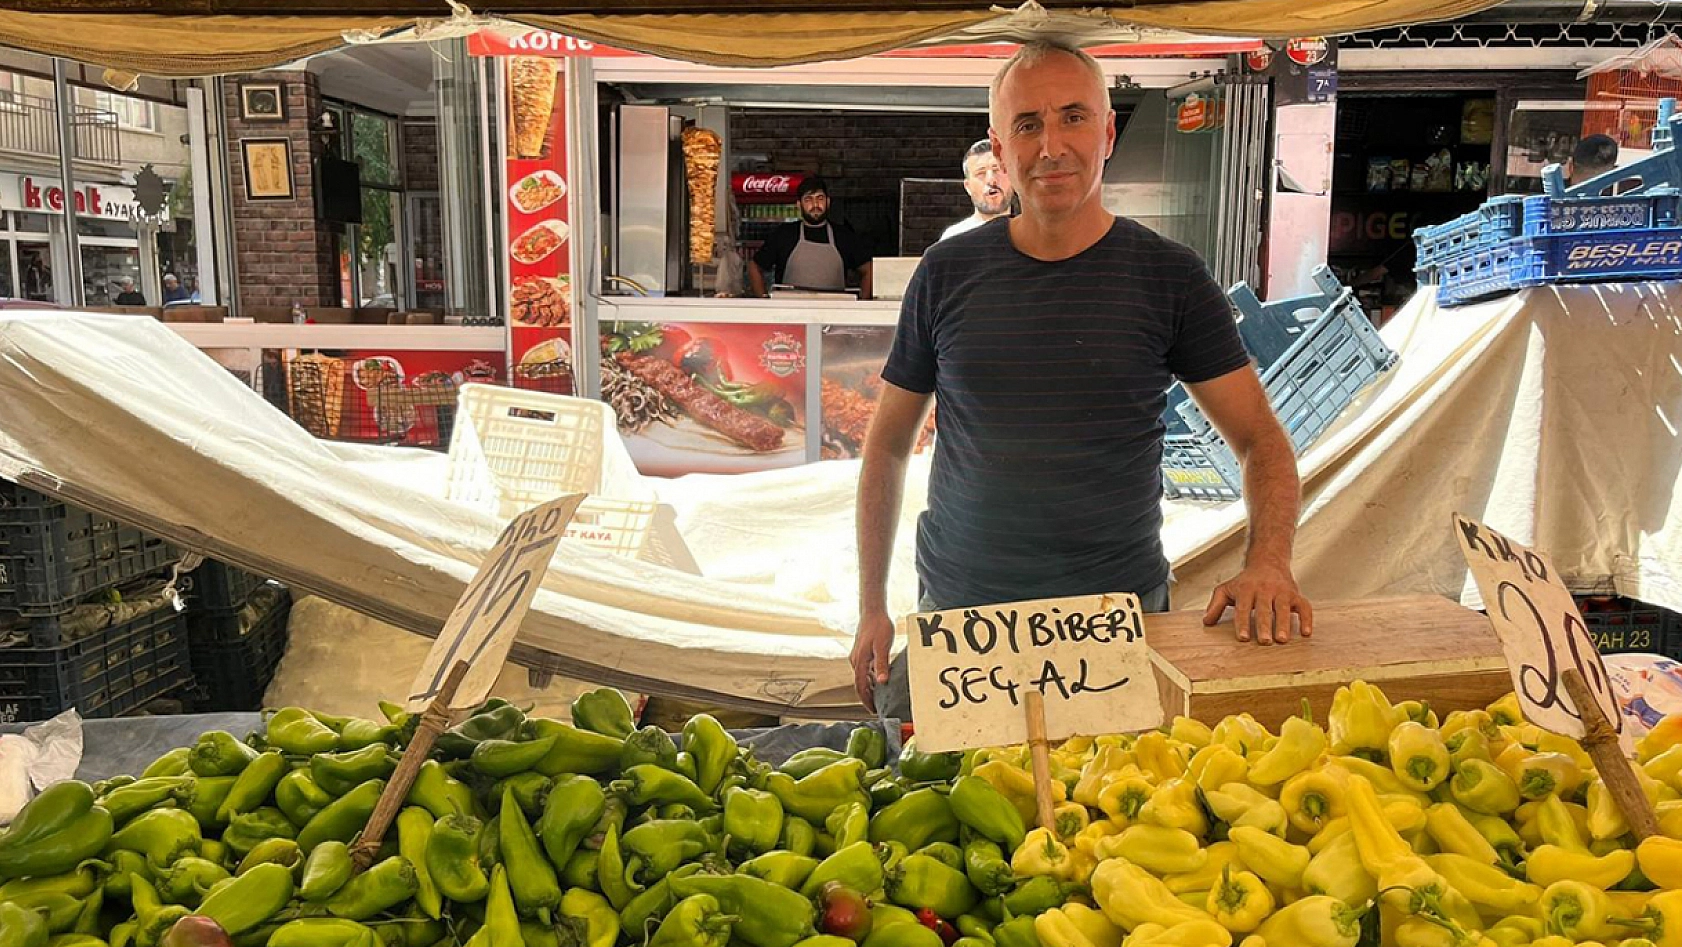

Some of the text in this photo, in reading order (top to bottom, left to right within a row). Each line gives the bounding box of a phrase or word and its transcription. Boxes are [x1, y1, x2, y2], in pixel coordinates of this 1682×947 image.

[24, 177, 102, 214] kent
[580, 530, 612, 541] KAYA
[917, 609, 1020, 654] KÖY
[1628, 630, 1650, 649] 23
[1030, 658, 1129, 700] AL
